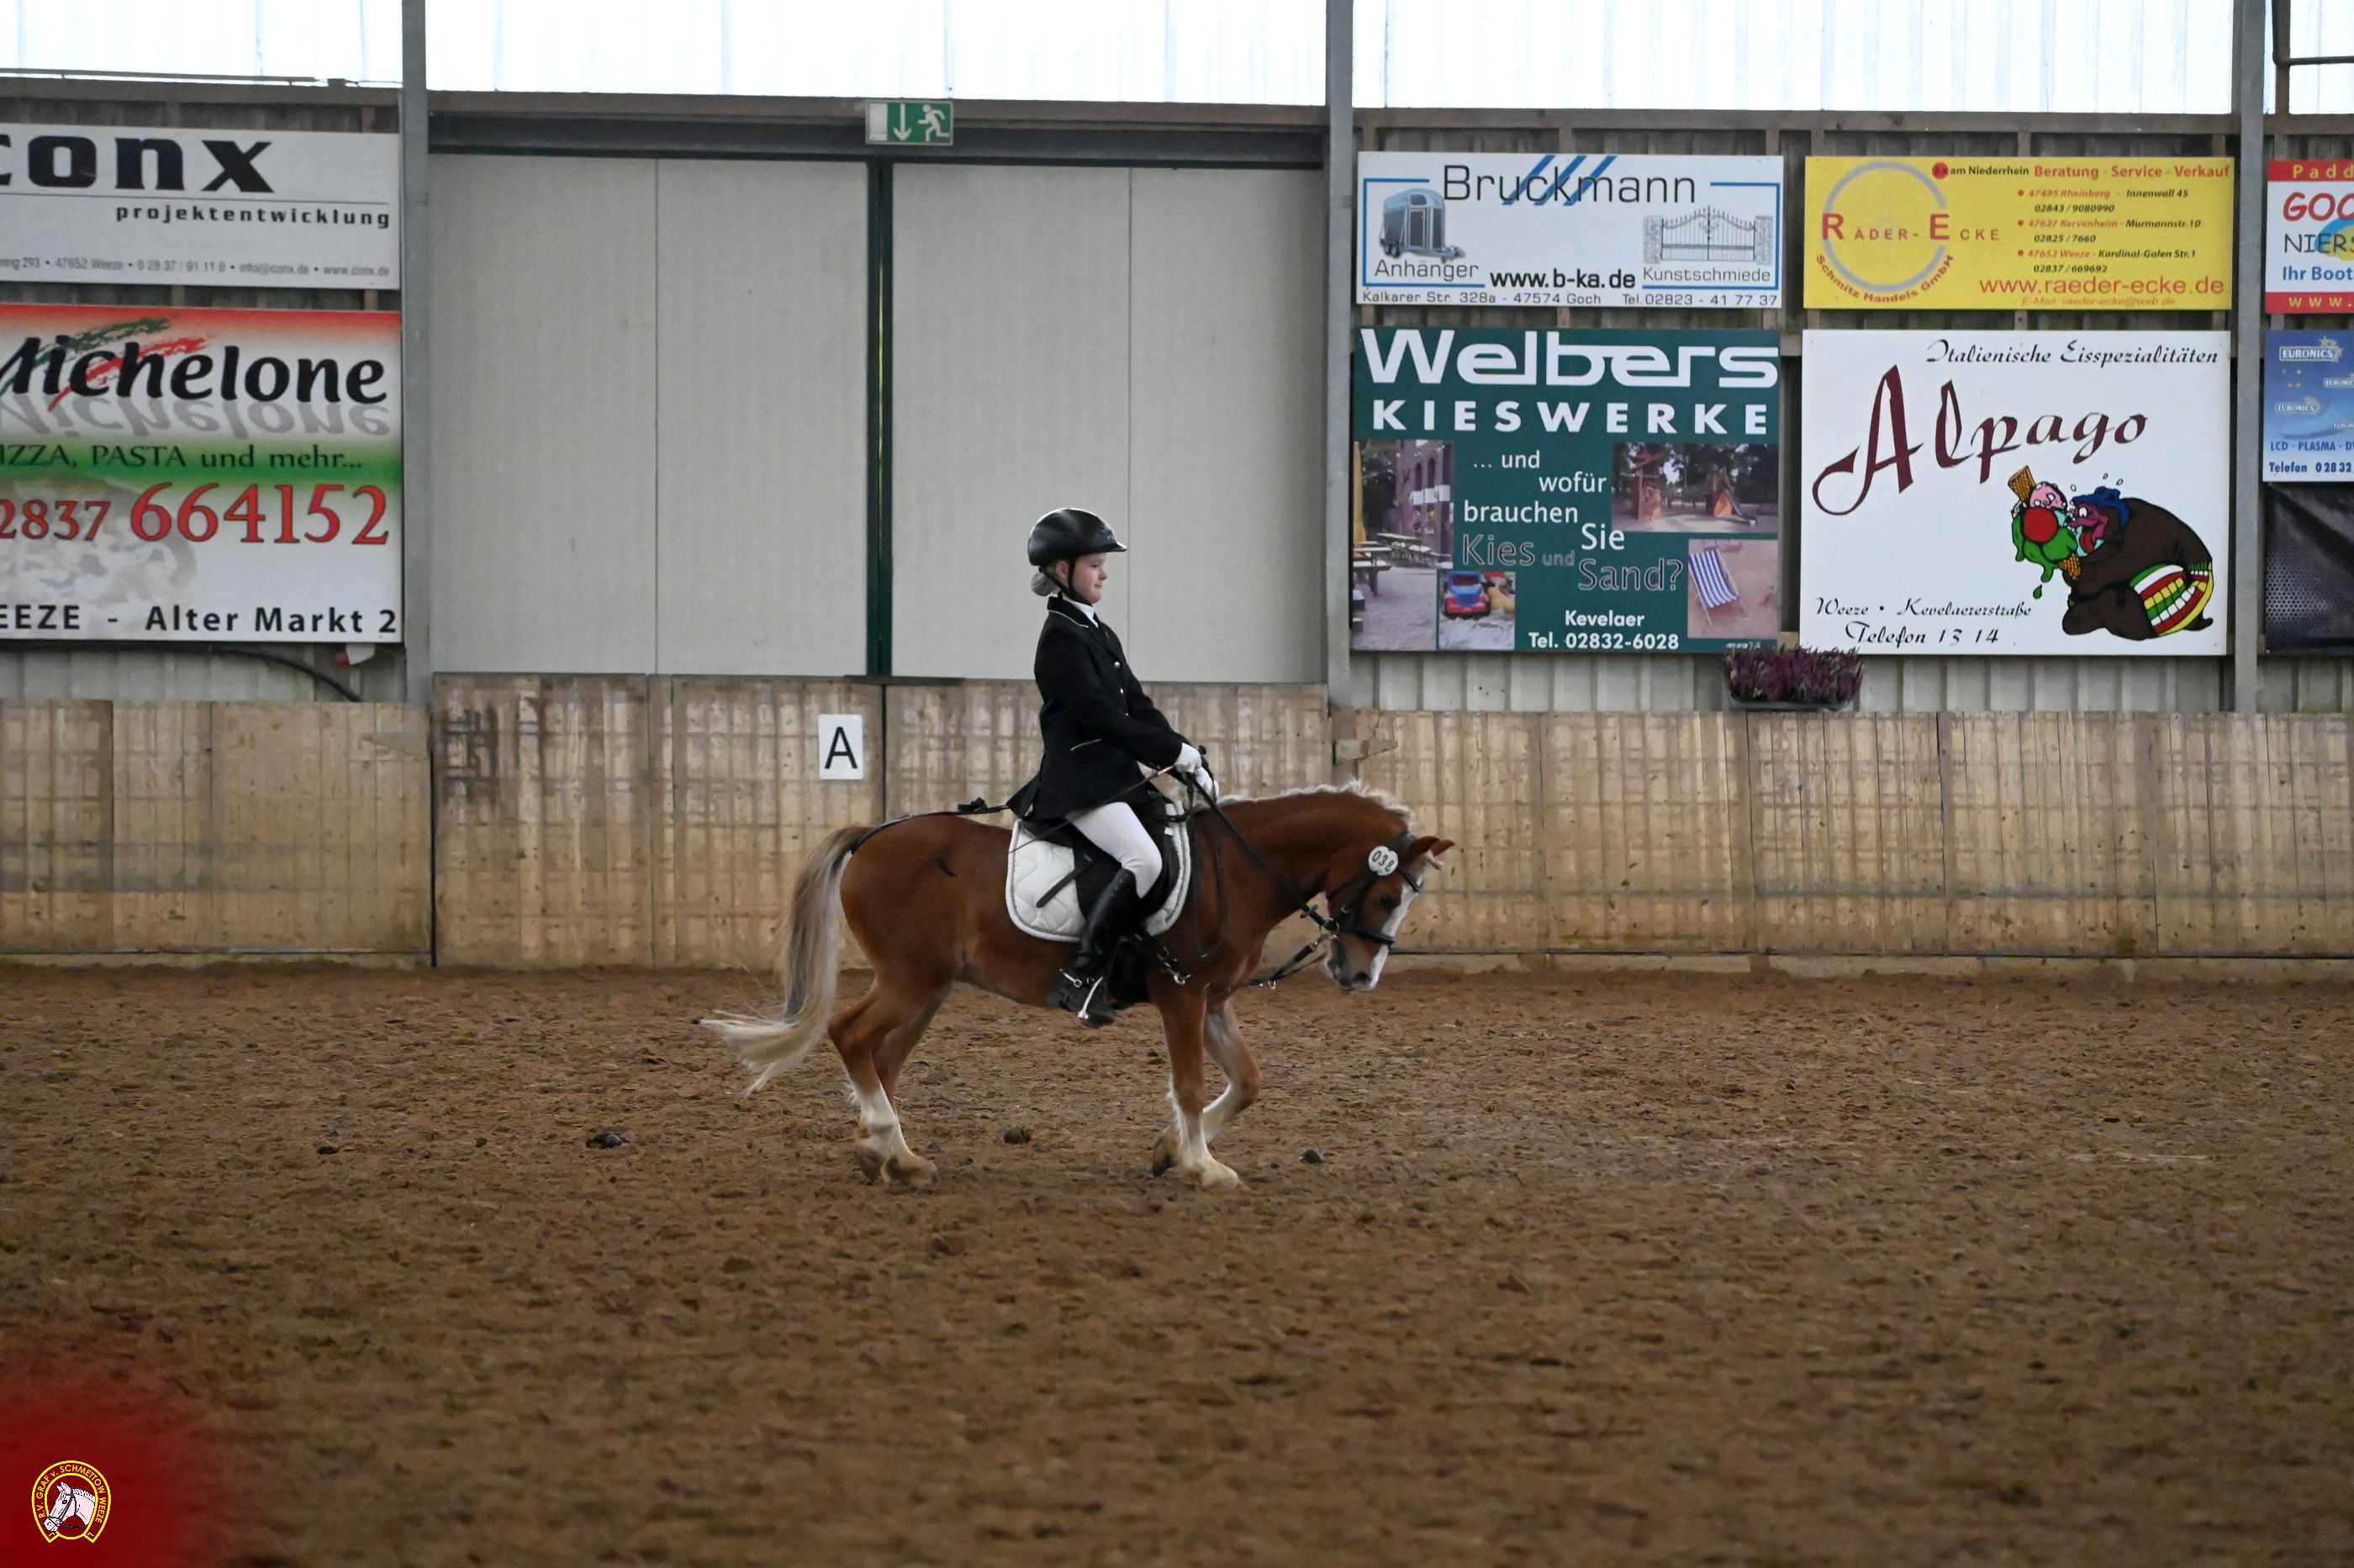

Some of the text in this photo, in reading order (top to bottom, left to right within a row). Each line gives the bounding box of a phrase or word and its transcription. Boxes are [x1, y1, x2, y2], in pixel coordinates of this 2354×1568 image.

[0, 135, 274, 193] onx
[1950, 166, 1966, 176] am
[1968, 166, 2029, 176] Niederrhein
[2034, 165, 2099, 180] Beratung
[2111, 165, 2162, 177] Service
[2174, 165, 2230, 177] Verkauf
[1444, 164, 1696, 203] Bruckmann
[2126, 189, 2175, 198] Innenwall
[116, 205, 390, 229] projektentwicklung
[2034, 235, 2064, 243] 02825
[2072, 235, 2096, 243] 7660
[1375, 259, 1479, 282] Anhänger
[1490, 267, 1636, 288] www.b-ka.de
[1643, 267, 1771, 282] Kunstschmiede
[1817, 255, 1955, 304] Schmitz Handels GmbH
[2033, 265, 2064, 273] 02837
[2283, 266, 2307, 281] Ihr
[1979, 275, 2225, 294] www.raeder-ecke.de
[1363, 291, 1421, 304] Kalkarer
[1459, 292, 1496, 304] 328a
[1513, 292, 1560, 304] 47574
[1566, 293, 1602, 305] Goch
[1709, 294, 1728, 306] 41
[1735, 294, 1751, 306] 77
[1759, 294, 1777, 307] 37
[1359, 329, 1779, 388] Welbers
[1925, 339, 2219, 368] Italienische Eisspezialitäten
[2282, 348, 2335, 359] EURONICS
[1373, 399, 1767, 436] KIESWERKE
[1812, 363, 2149, 515] Alpago
[2270, 441, 2288, 451] LCD
[2299, 441, 2336, 451] PLASMA
[92, 445, 187, 467] PASTA
[202, 445, 255, 468] und
[269, 444, 362, 468] mehr...
[1501, 450, 1540, 469] und
[2269, 462, 2308, 473] Telefon
[1538, 471, 1607, 494] wofür
[130, 482, 389, 545] 664152
[1464, 499, 1578, 524] brauchen
[1581, 523, 1626, 551] Sie
[1461, 534, 1683, 591] Kies und Sand?
[1816, 597, 1869, 615] Weeze
[145, 604, 239, 631] Alter
[255, 606, 363, 633] Markt
[378, 609, 397, 633] 2
[1565, 610, 1645, 627] Kevelaer
[1528, 631, 1680, 650] Tel. 02832-6028
[1845, 620, 2000, 649] Telefon 13 14
[824, 726, 858, 769] A
